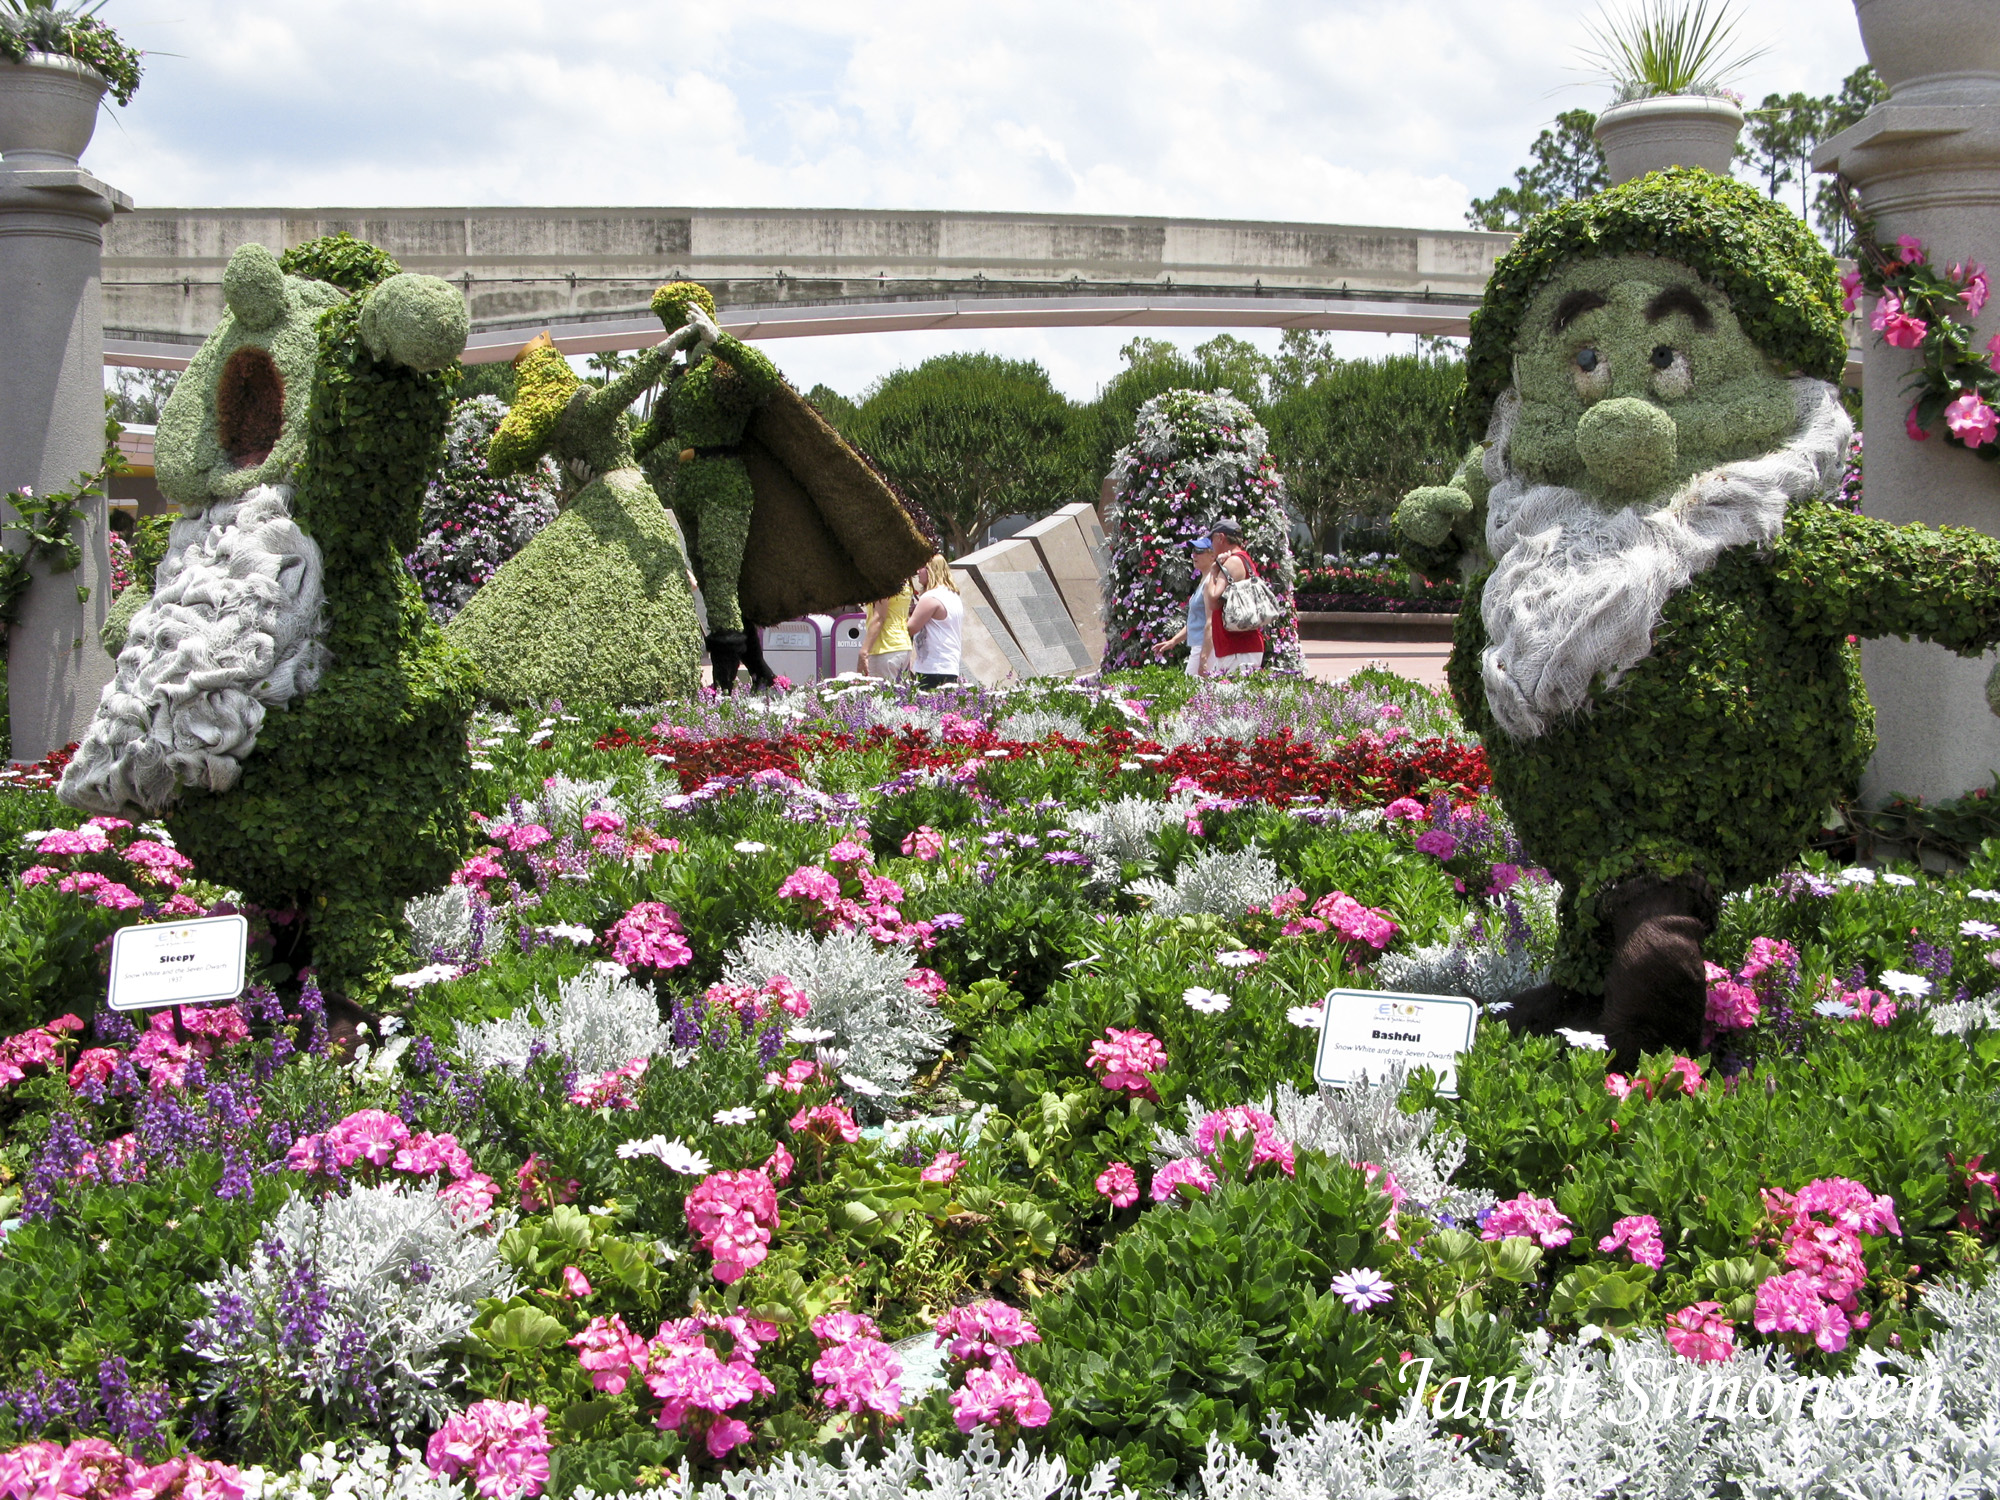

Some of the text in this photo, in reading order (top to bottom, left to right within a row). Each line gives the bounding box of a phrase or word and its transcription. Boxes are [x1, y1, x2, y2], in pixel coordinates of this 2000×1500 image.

[159, 953, 196, 963] Sleepy
[1378, 1003, 1424, 1016] EPCOT
[1371, 1030, 1421, 1042] Bashful
[1334, 1042, 1353, 1051] Snow
[1354, 1044, 1376, 1053] White
[1405, 1049, 1426, 1057] Seven
[1427, 1051, 1453, 1060] Dwarfs
